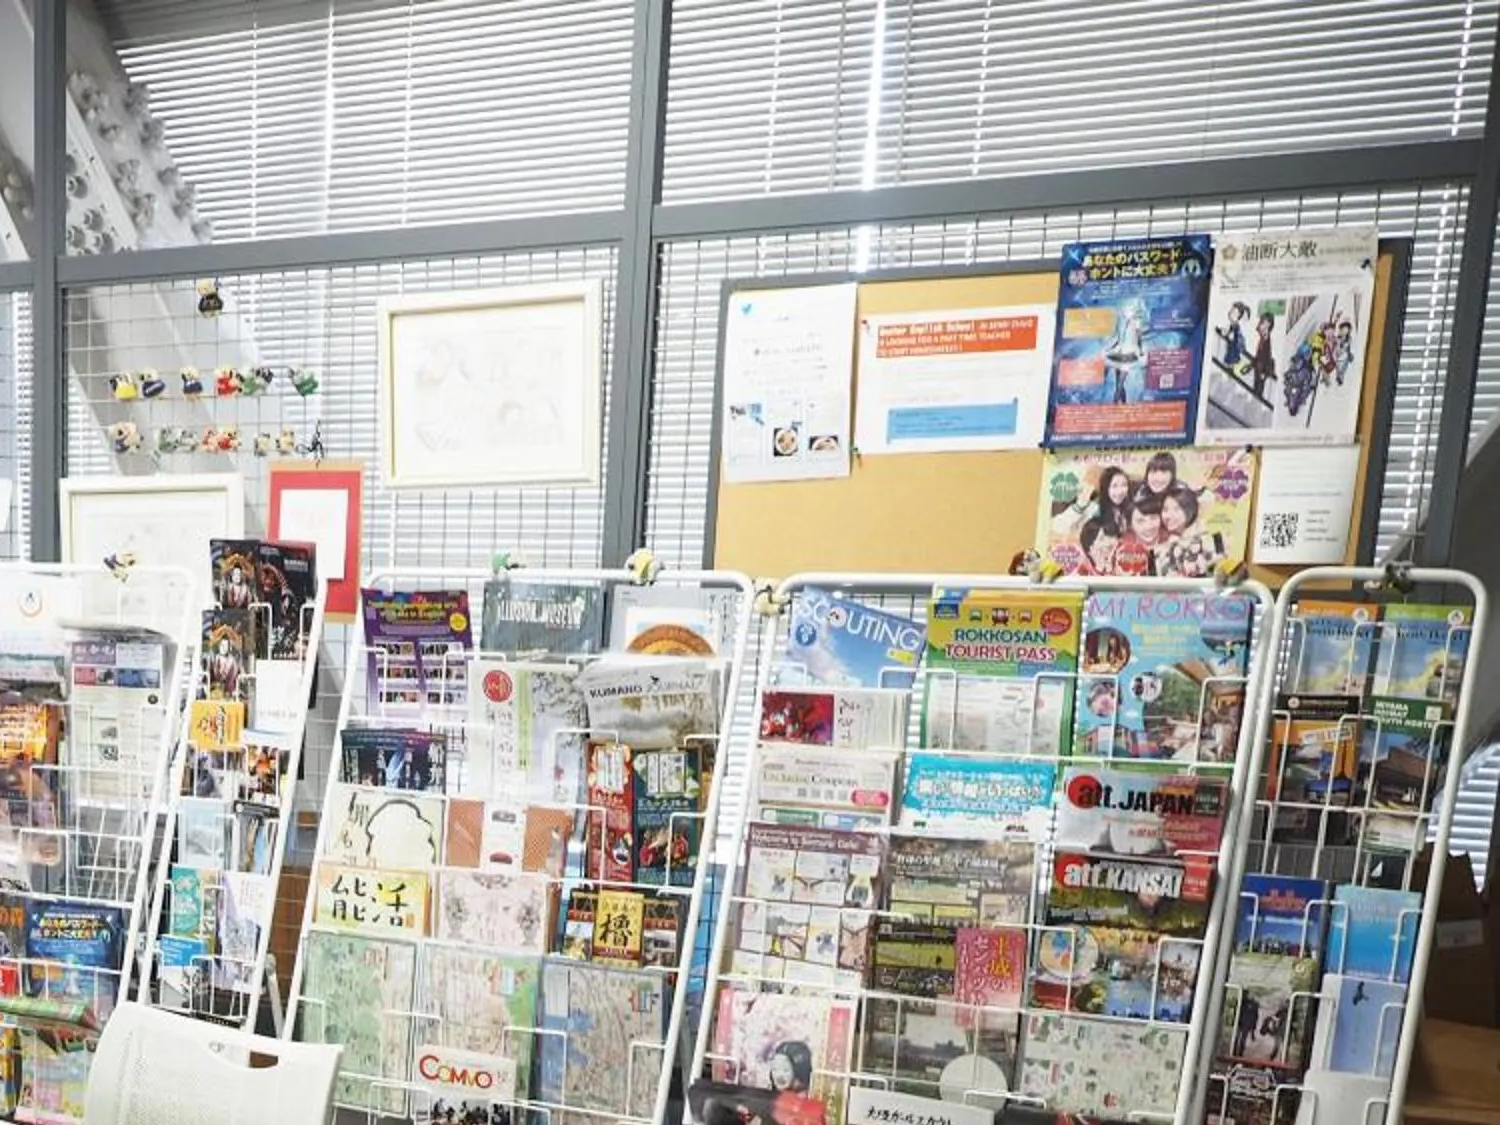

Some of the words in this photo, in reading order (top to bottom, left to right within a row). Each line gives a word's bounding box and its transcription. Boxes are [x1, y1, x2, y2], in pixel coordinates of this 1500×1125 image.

[954, 628, 1047, 643] ROKKOSAN
[946, 643, 1011, 660] TOURIST
[1016, 647, 1057, 662] PASS
[1063, 861, 1185, 898] att.KANSAI
